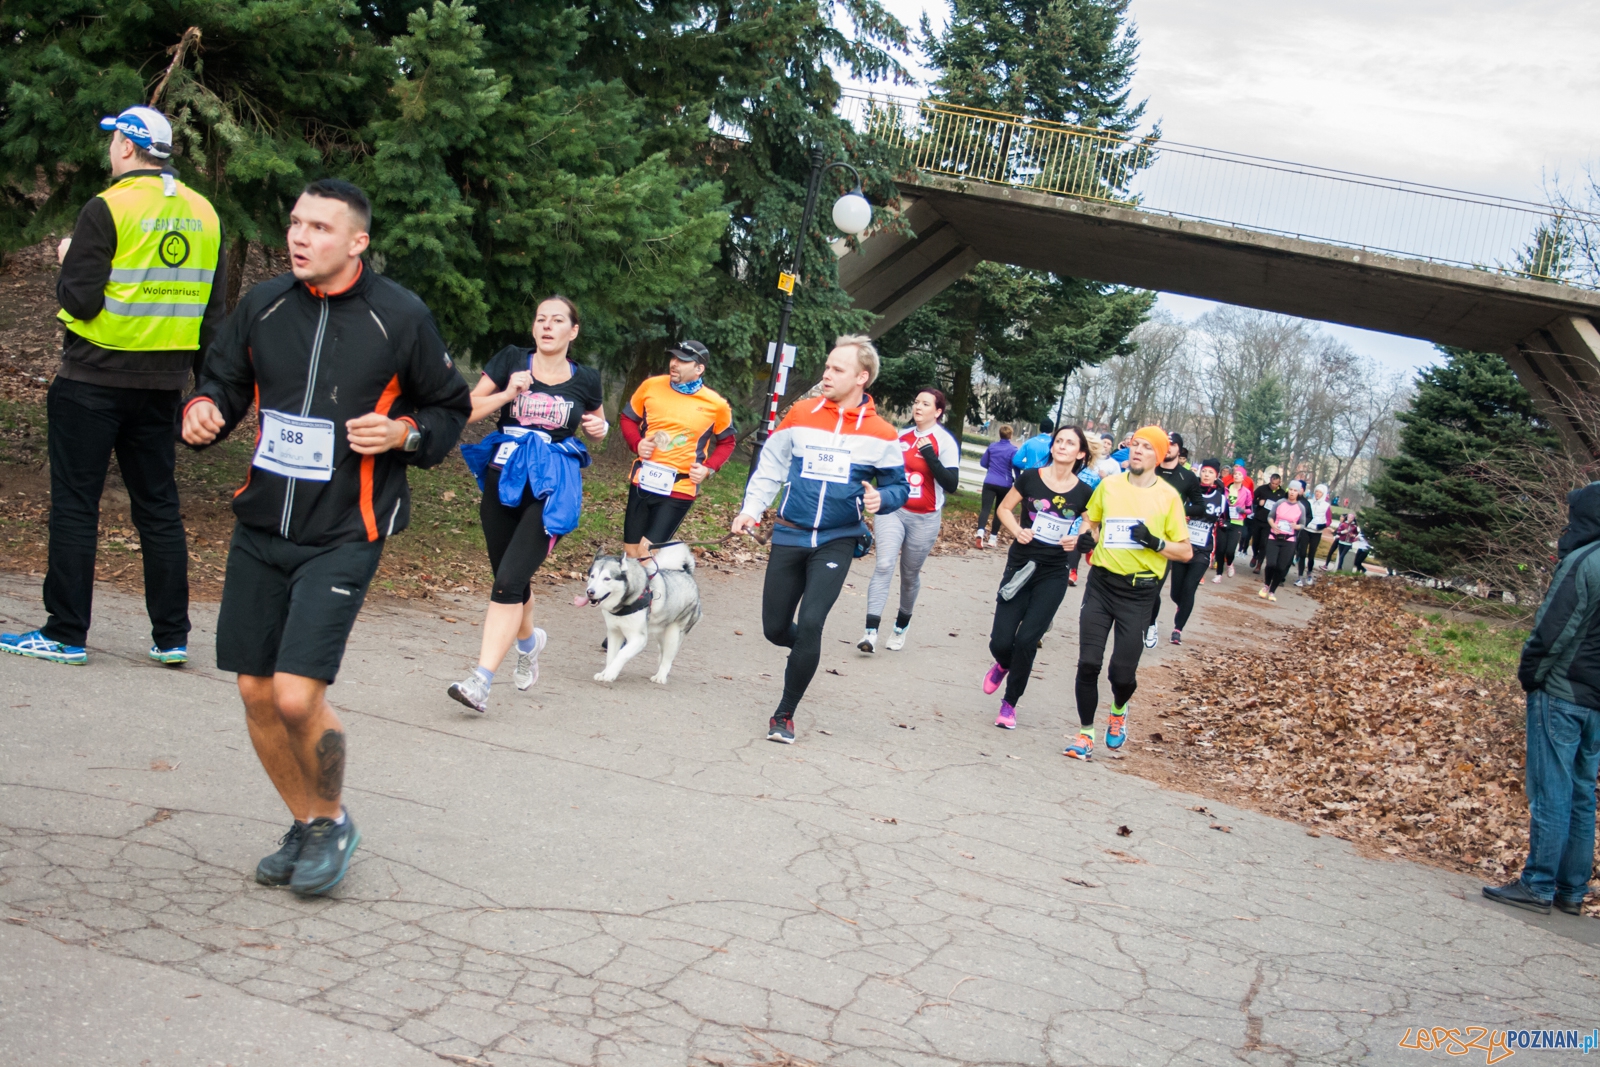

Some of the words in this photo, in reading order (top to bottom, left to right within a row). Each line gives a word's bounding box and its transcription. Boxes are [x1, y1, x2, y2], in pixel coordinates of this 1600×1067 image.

[141, 218, 203, 232] ORGANIZATOR
[143, 287, 200, 297] Wolontariusz
[510, 394, 574, 429] EVERLAST
[281, 428, 304, 445] 688
[818, 453, 834, 462] 588
[648, 469, 663, 479] 667
[1047, 522, 1060, 532] 515
